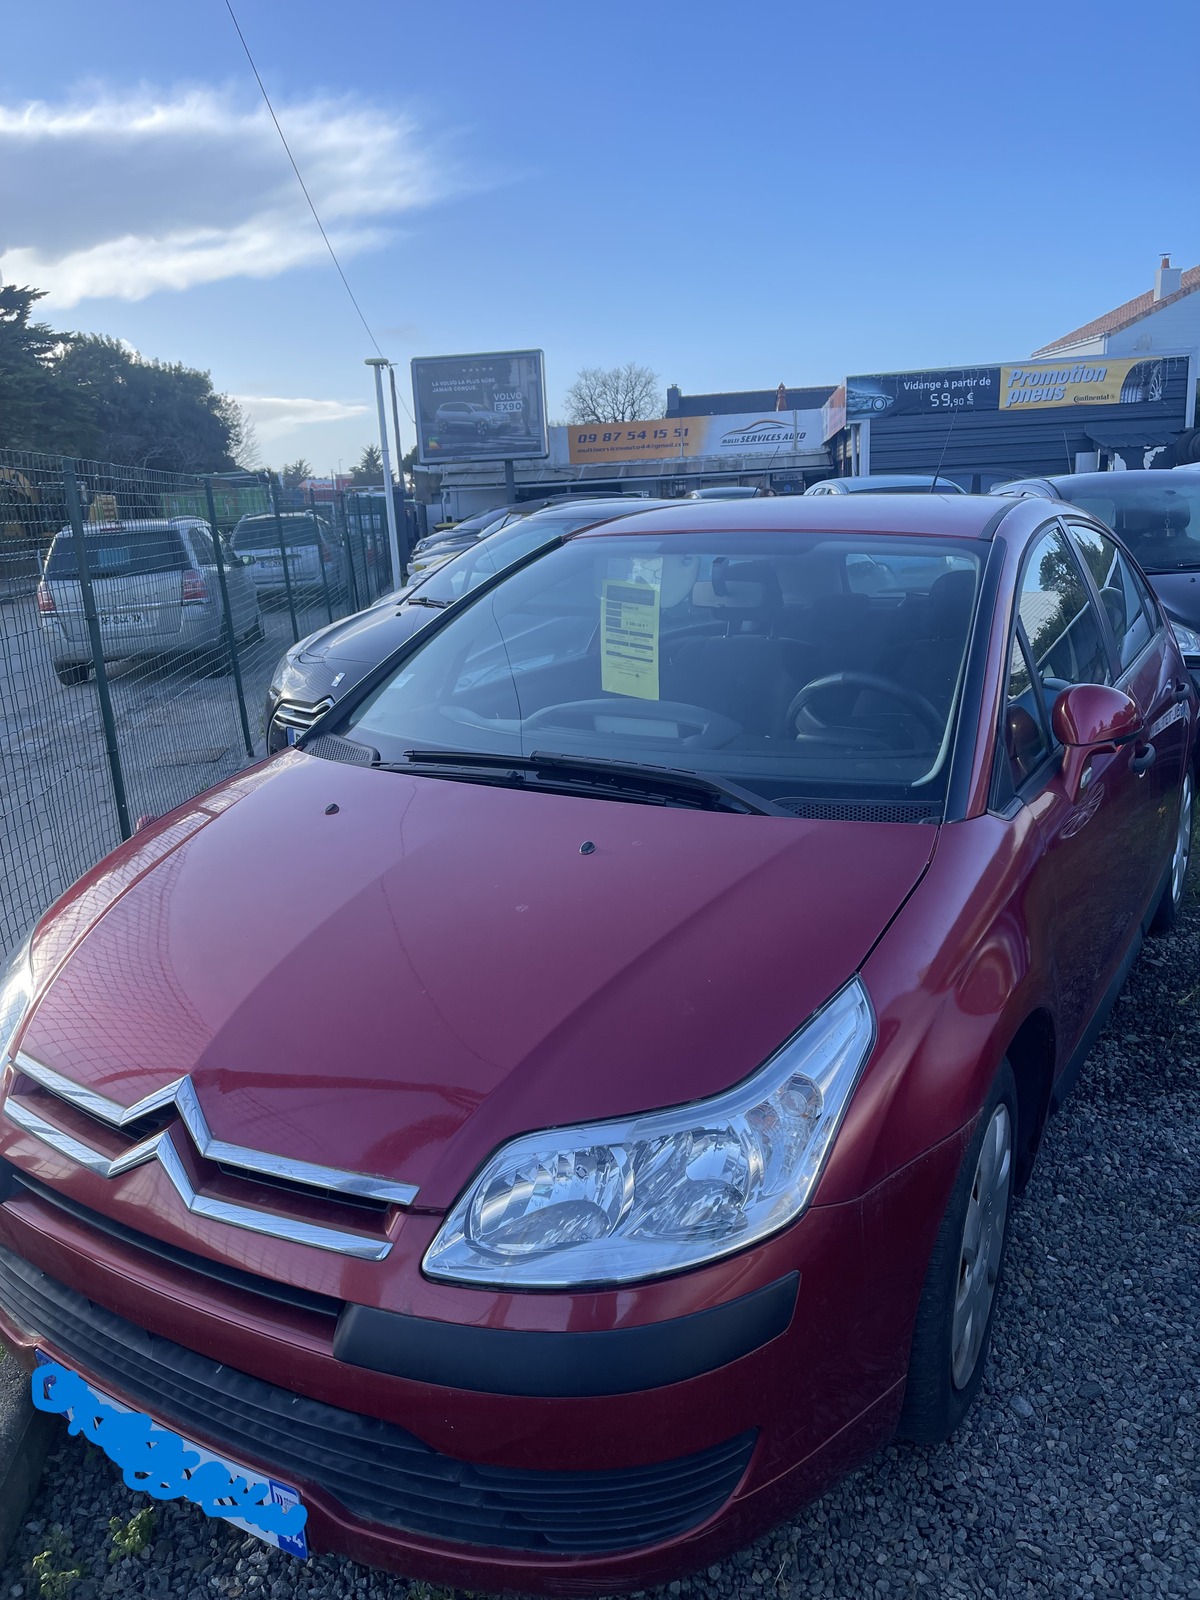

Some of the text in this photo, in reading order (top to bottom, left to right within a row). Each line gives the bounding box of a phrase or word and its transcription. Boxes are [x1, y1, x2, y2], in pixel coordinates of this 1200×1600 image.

[1007, 363, 1108, 388] Promotion
[903, 377, 991, 391] Vidange à partir de
[493, 391, 523, 401] VOLVO
[1006, 385, 1067, 408] pneus
[1073, 393, 1110, 404] Continental
[496, 402, 522, 411] EX90
[577, 427, 689, 444] 09 87 54 15 51
[740, 432, 782, 443] SERVICES
[782, 431, 807, 440] AUTO
